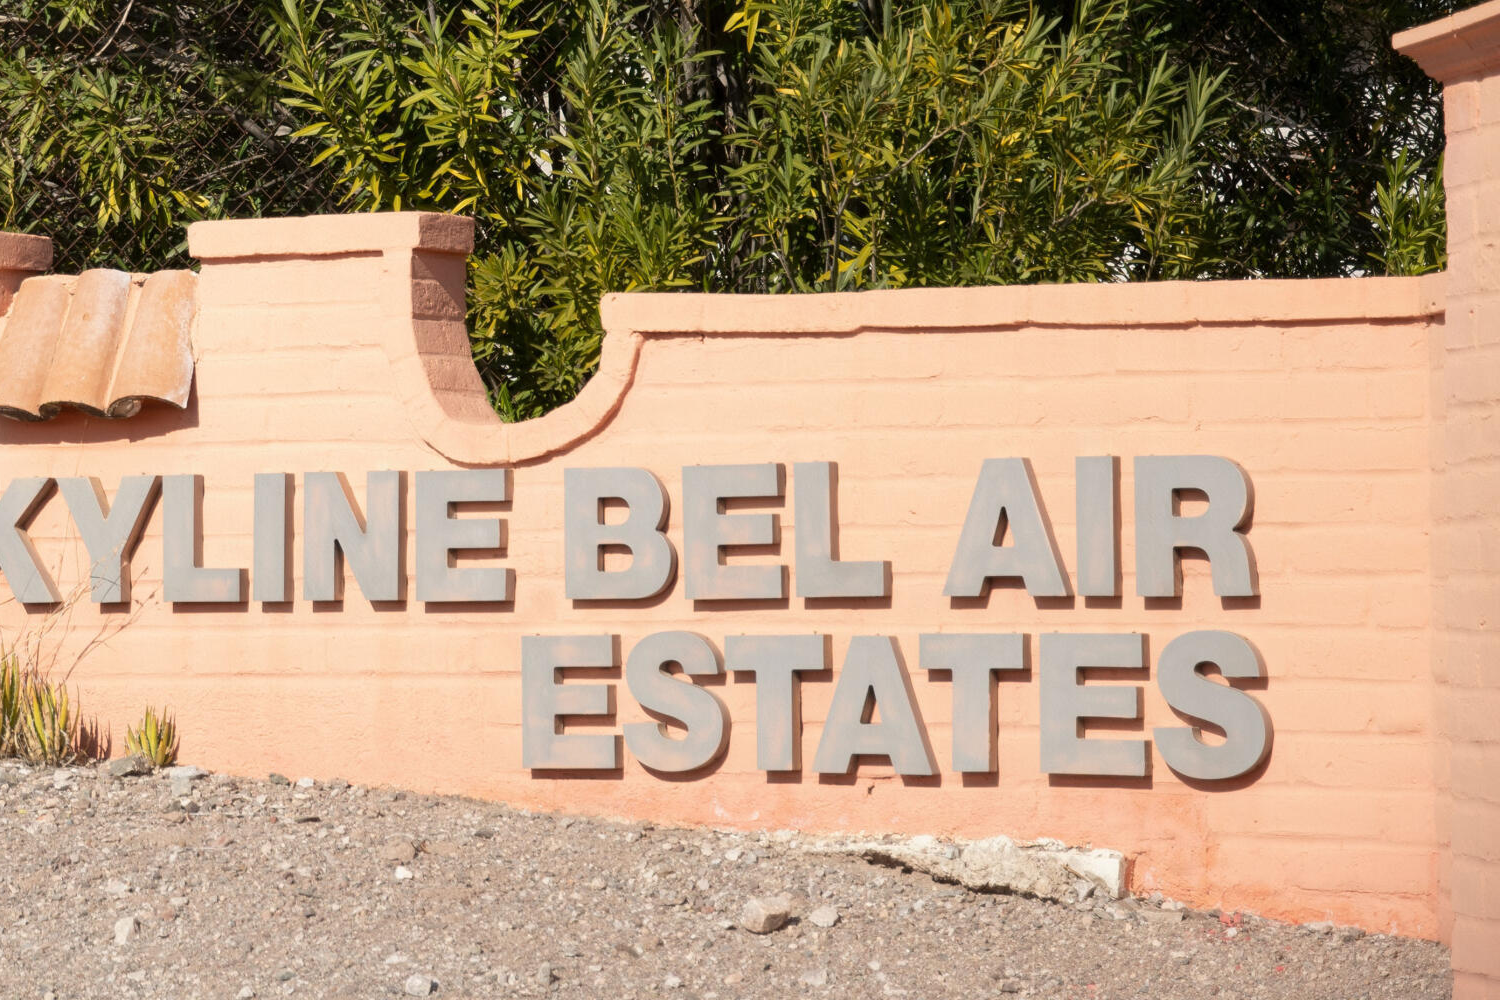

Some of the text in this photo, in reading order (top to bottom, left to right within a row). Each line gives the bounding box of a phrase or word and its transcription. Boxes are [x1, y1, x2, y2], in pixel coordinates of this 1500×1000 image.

[564, 461, 891, 602] BEL
[942, 455, 1261, 600] AIR
[521, 629, 1274, 781] ESTATES
